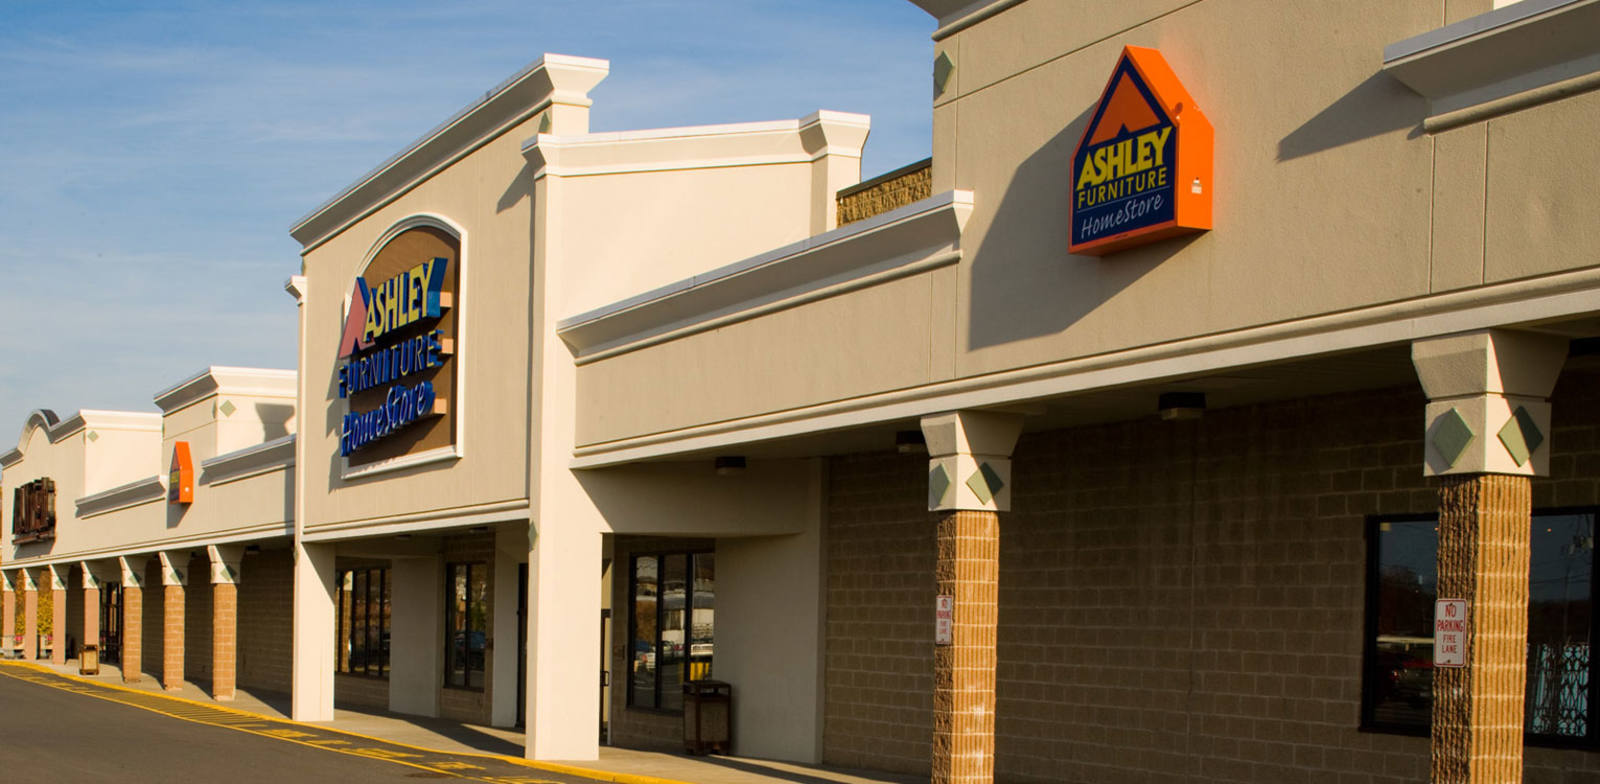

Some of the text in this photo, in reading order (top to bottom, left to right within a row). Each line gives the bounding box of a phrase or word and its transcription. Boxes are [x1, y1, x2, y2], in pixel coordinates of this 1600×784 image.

[1076, 126, 1172, 191] ASHLEY
[1078, 167, 1167, 209] FURNITURE
[1081, 193, 1164, 240] HomeStore
[362, 257, 443, 343] ASHLEY
[339, 330, 442, 398] FURNITURE
[1437, 620, 1464, 632] PARKING
[1445, 605, 1456, 617] NO
[1442, 645, 1457, 653] LANE
[1443, 635, 1456, 644] FIRE
